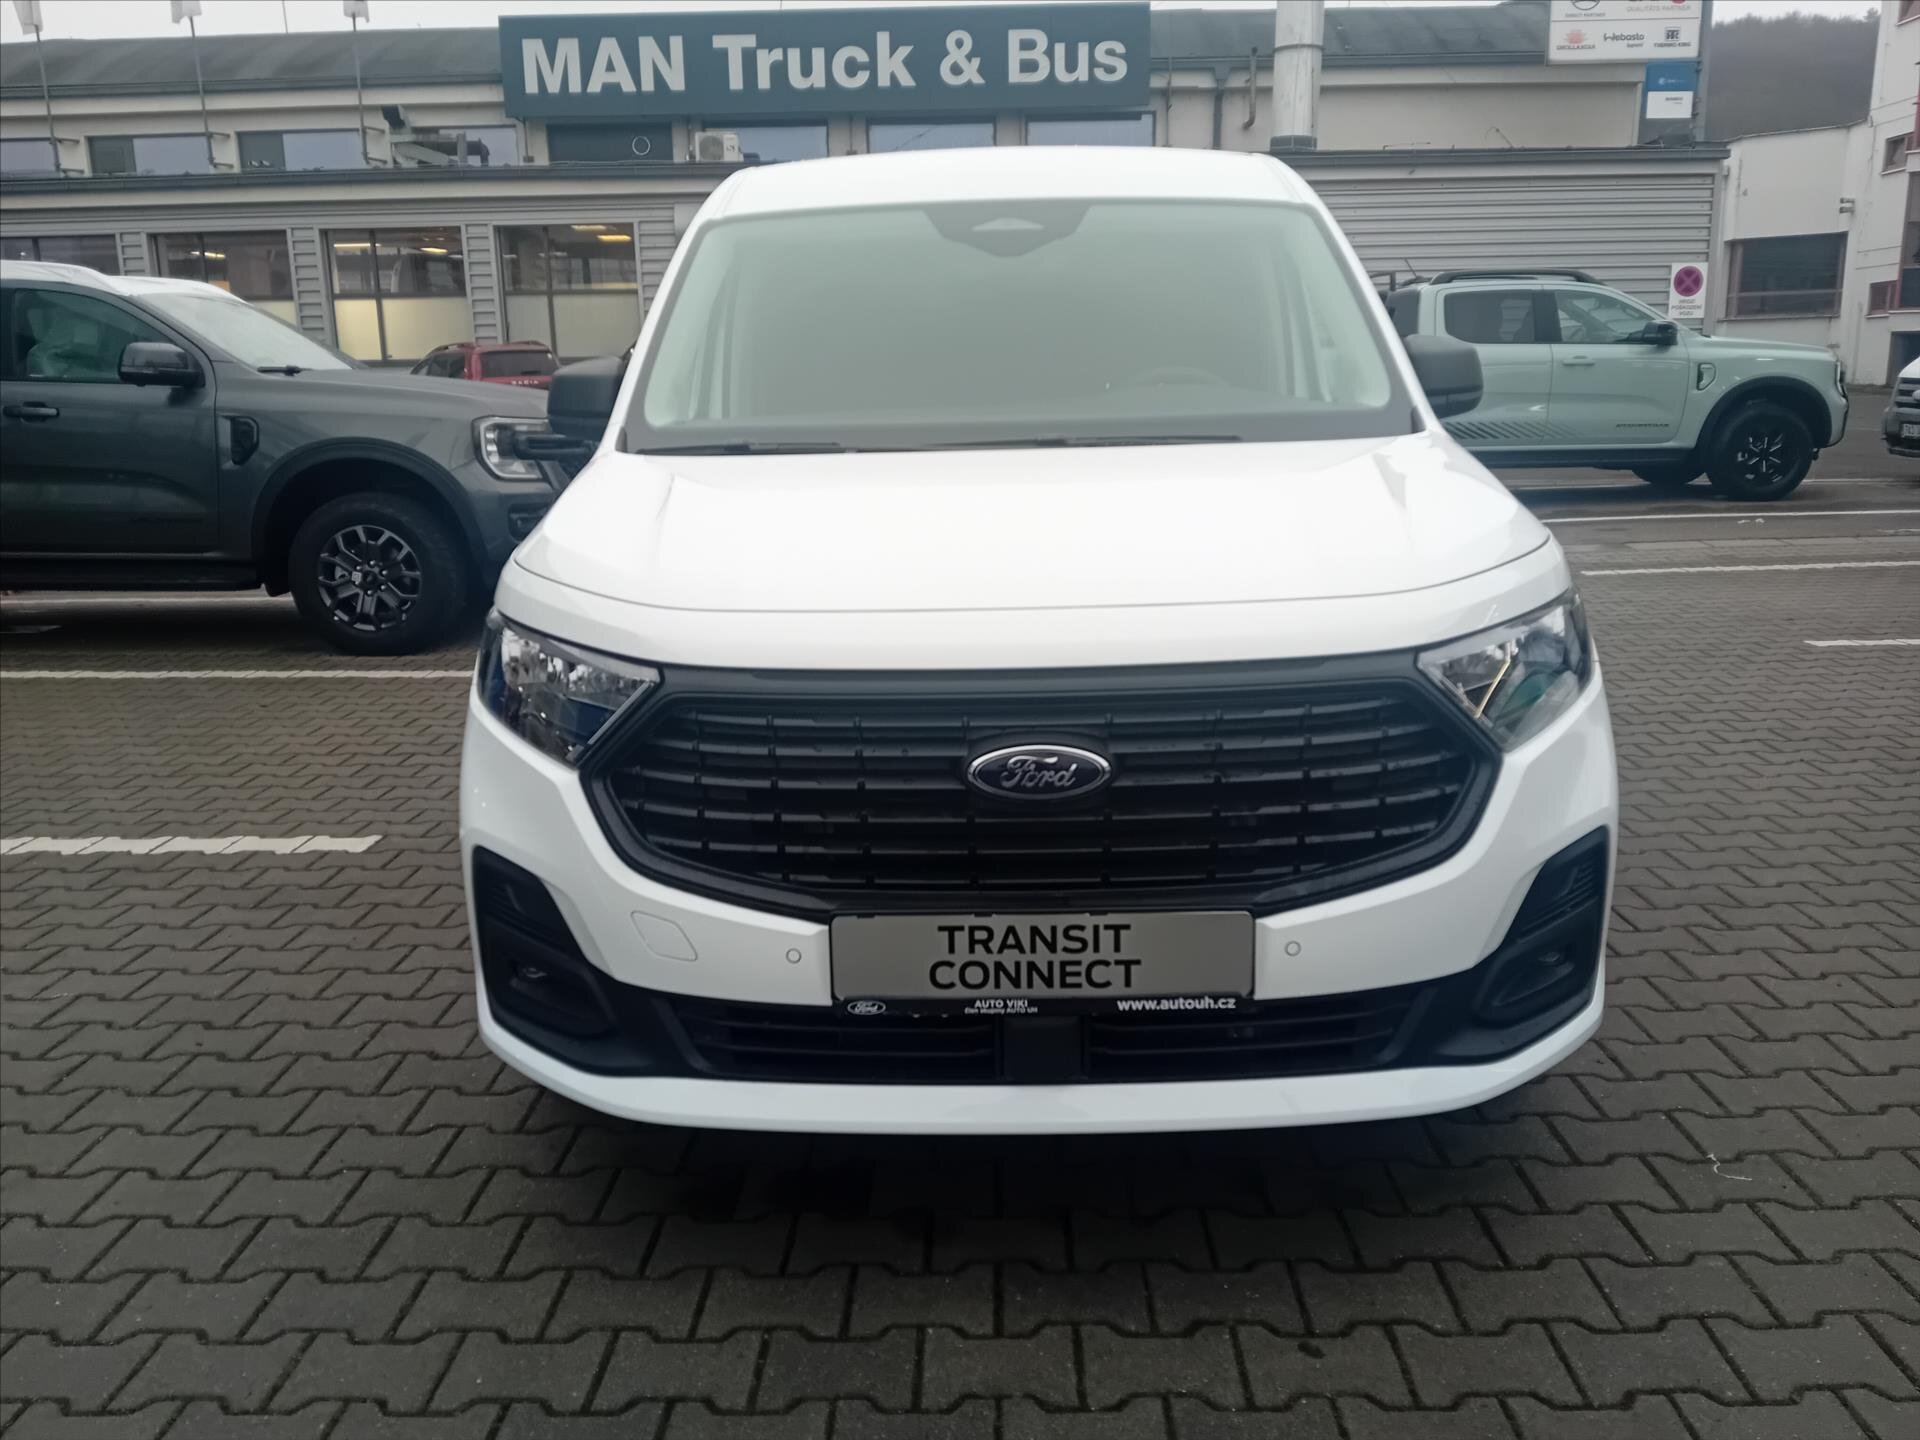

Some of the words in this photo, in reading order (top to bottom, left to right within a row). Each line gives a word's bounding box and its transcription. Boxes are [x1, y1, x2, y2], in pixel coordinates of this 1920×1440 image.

[1603, 31, 1645, 42] Webasto
[521, 35, 686, 94] MAN
[711, 31, 916, 90] Truck
[939, 29, 986, 87] &
[1007, 28, 1128, 84] Bus
[1001, 755, 1077, 788] Ford
[937, 924, 1131, 955] TRANSIT
[929, 959, 1141, 990] CONNECT
[974, 999, 1004, 1008] AUTO
[1007, 999, 1028, 1008] VIKI
[1117, 996, 1236, 1011] www.autouh.cz
